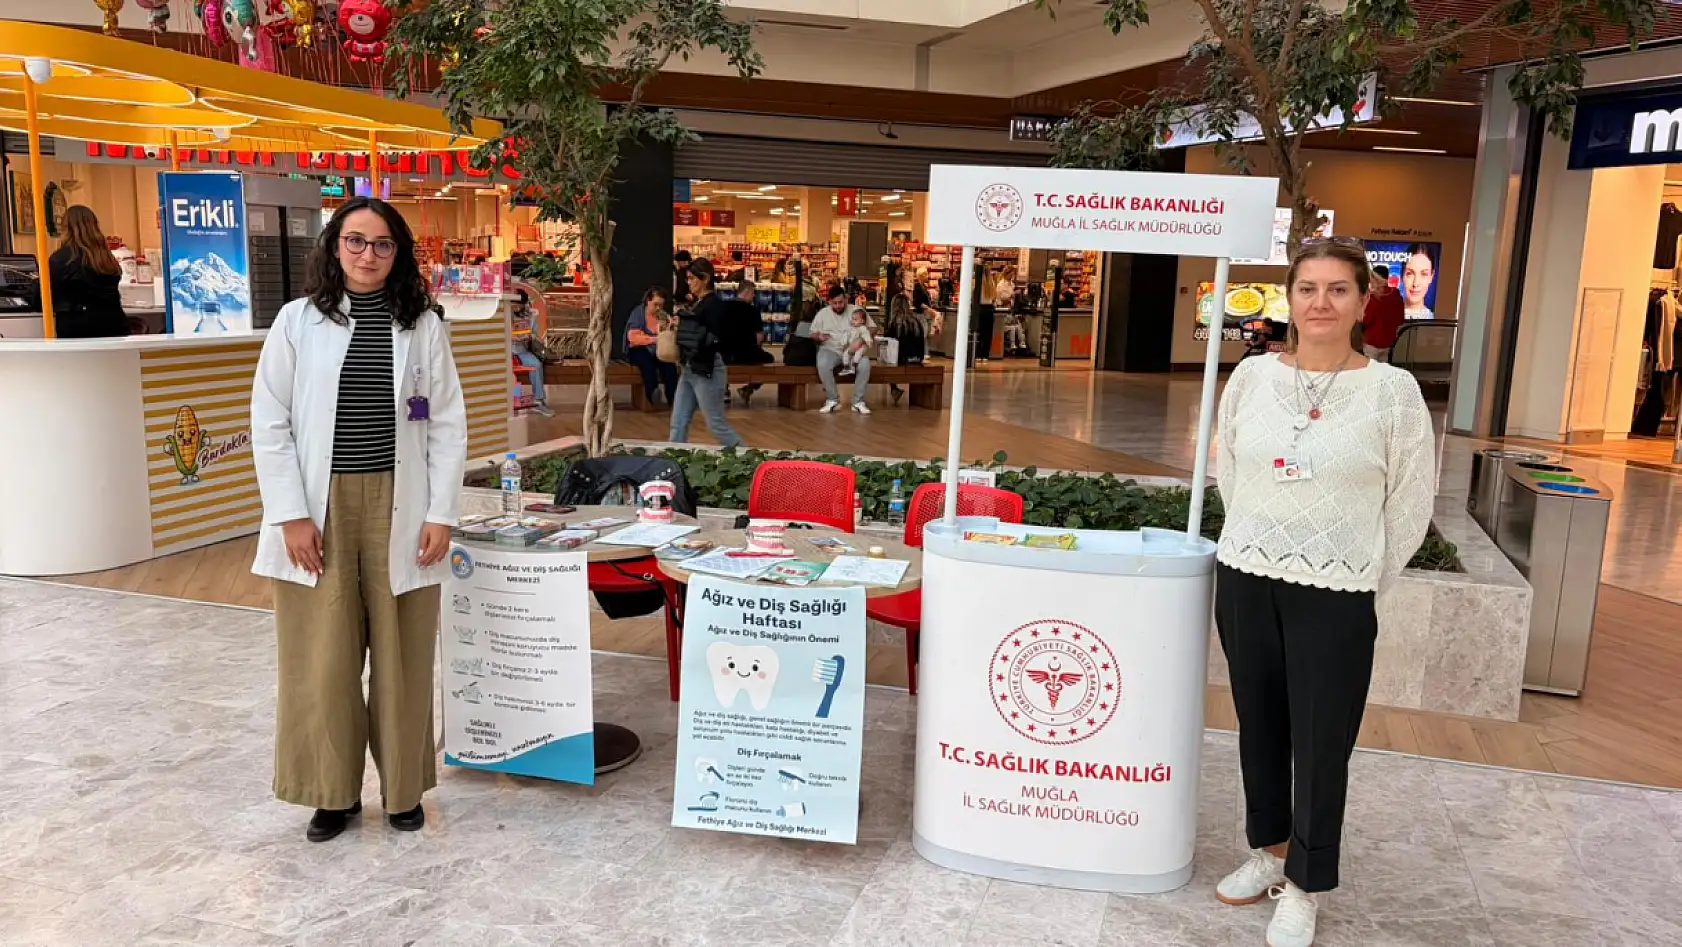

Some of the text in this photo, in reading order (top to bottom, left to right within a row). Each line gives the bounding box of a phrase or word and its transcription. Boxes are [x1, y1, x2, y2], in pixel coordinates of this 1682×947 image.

[1034, 192, 1225, 215] T.C. SAĞLIK BAKANLIĞI
[173, 199, 235, 228] Erikli
[1031, 215, 1223, 236] MUĞLA İL SAĞLIK MÜDÜRLÜĞÜ
[1380, 251, 1412, 263] TOUCH
[502, 564, 519, 573] AĞIZ
[533, 565, 546, 574] DİŞ
[548, 564, 581, 573] SAĞLIĞI
[506, 576, 540, 584] MERKEZİ
[702, 588, 846, 616] Ağız ve Diş Sağlığı
[742, 612, 802, 630] Haftası
[707, 625, 728, 636] Ağız
[742, 629, 757, 639] Diş
[760, 630, 806, 642] Sağlığının
[808, 634, 839, 643] Önemi
[737, 747, 802, 761] Diş Fırçalamak
[939, 742, 1171, 783] T.C. SAĞLIK BAKANLIĞI
[1021, 785, 1079, 802] MUĞLA
[963, 792, 1139, 826] İL SAĞLIK MÜDÜRLÜĞÜ
[697, 815, 725, 826] Fethiye
[726, 818, 744, 828] Ağız
[755, 821, 768, 831] Diş
[769, 822, 794, 833] Sağlığı
[796, 826, 827, 836] Merkezi
